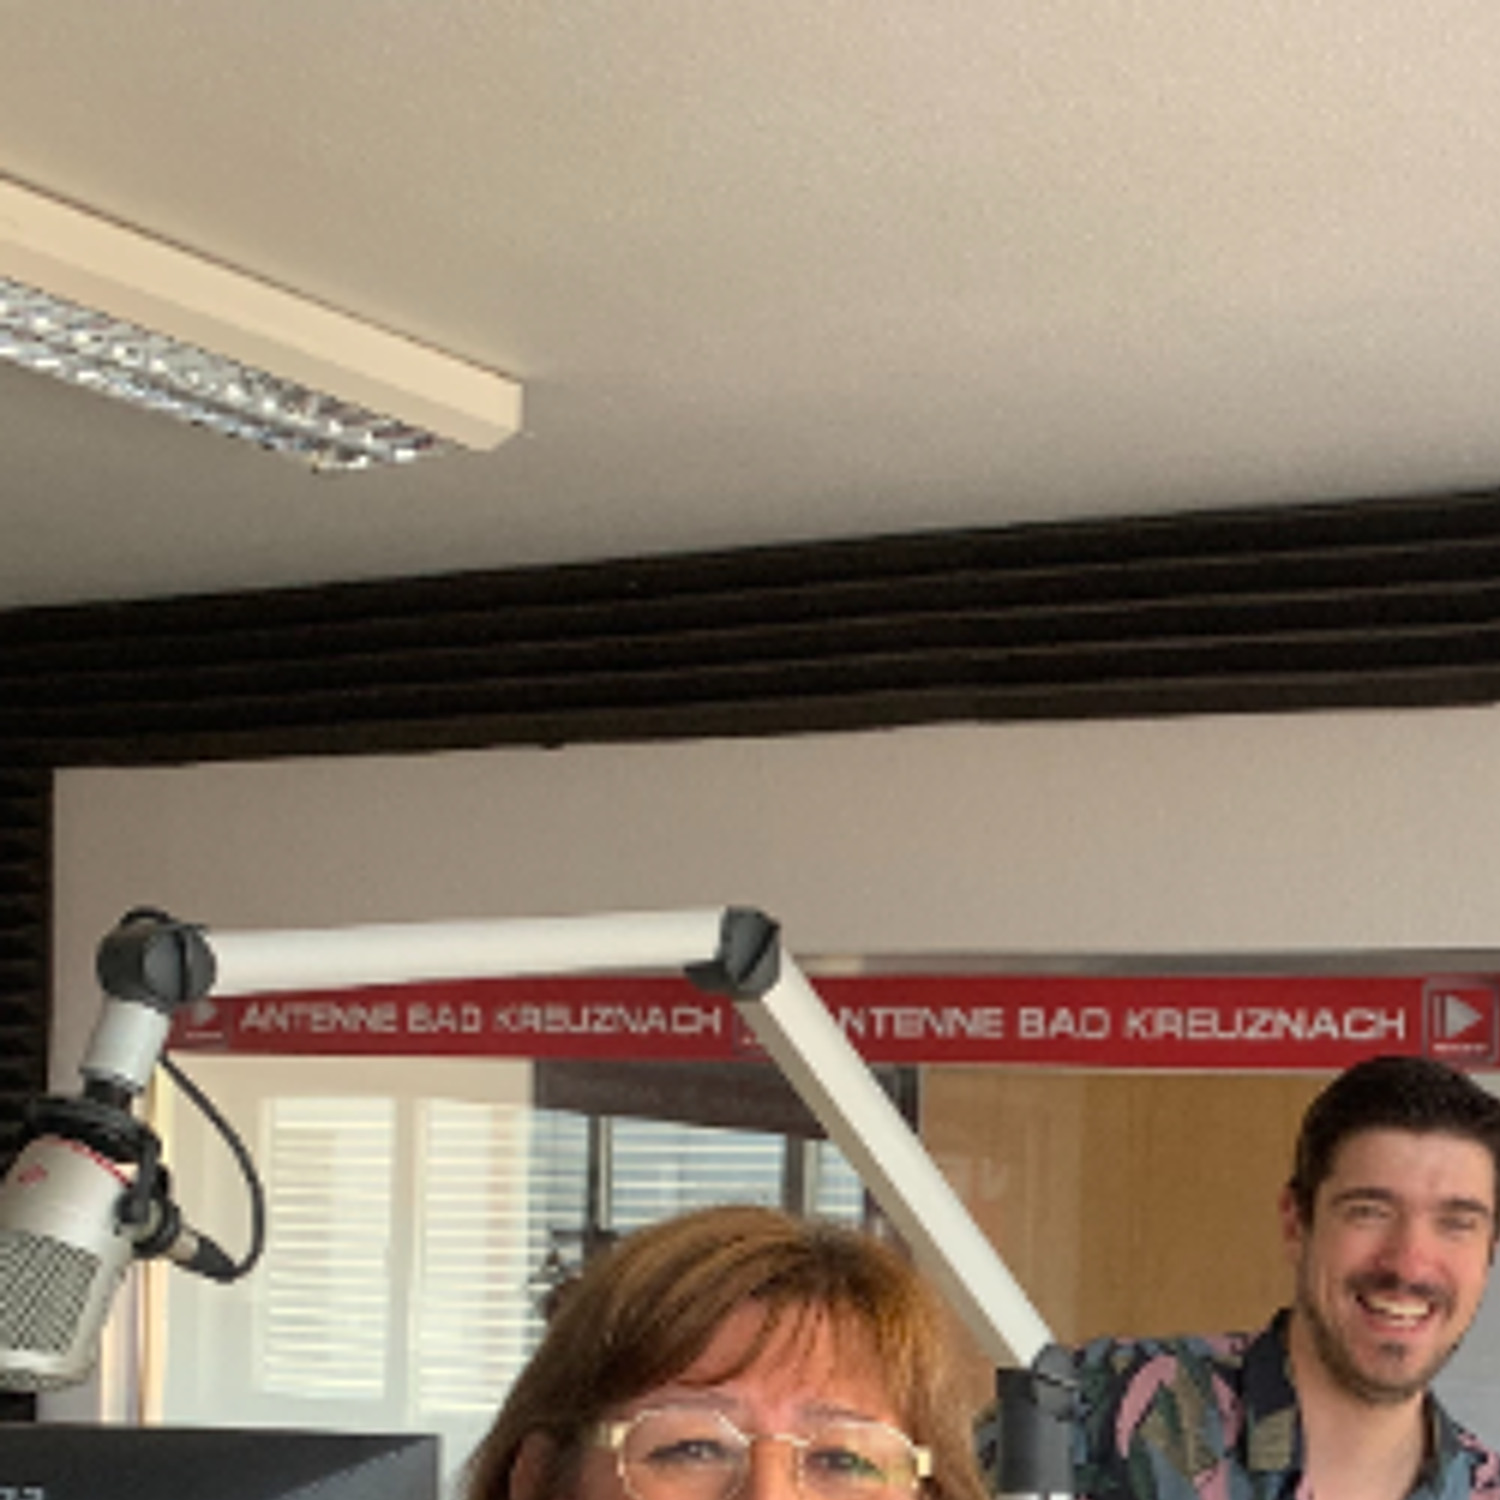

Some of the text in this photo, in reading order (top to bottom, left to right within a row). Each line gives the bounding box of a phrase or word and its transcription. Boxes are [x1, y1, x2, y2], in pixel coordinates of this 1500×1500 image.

[240, 1002, 722, 1035] ANTENNE BAD KREUZNACH
[832, 1006, 1406, 1039] NTENNE BAD KREUZNACH
